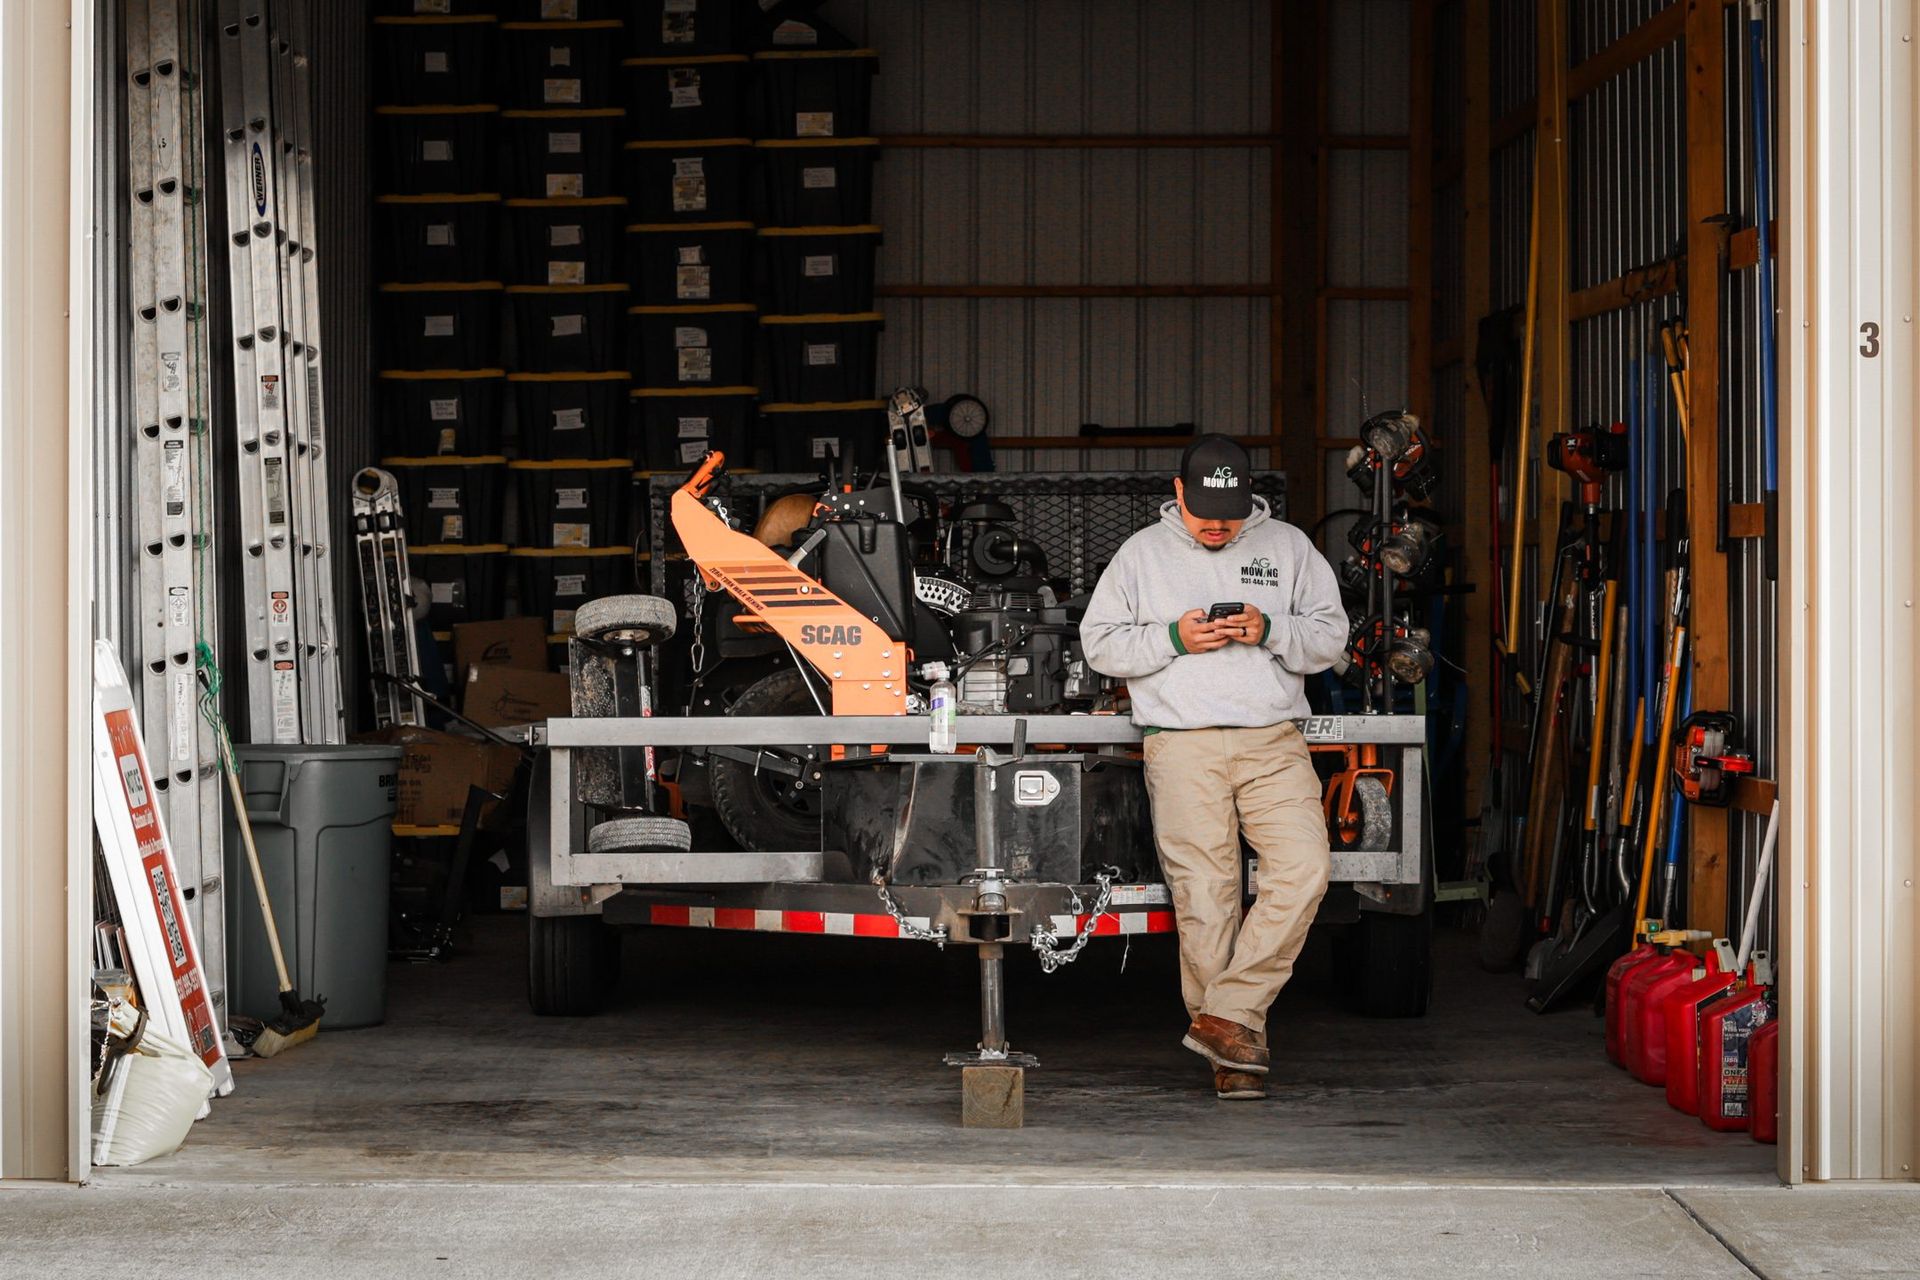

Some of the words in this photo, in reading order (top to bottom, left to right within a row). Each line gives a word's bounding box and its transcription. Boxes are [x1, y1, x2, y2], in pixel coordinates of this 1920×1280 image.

[255, 157, 264, 201] WERNER
[1860, 322, 1879, 358] 3
[1213, 466, 1232, 479] AG
[1251, 557, 1270, 569] AG
[1241, 566, 1278, 578] MOWING
[801, 625, 862, 645] SCAG
